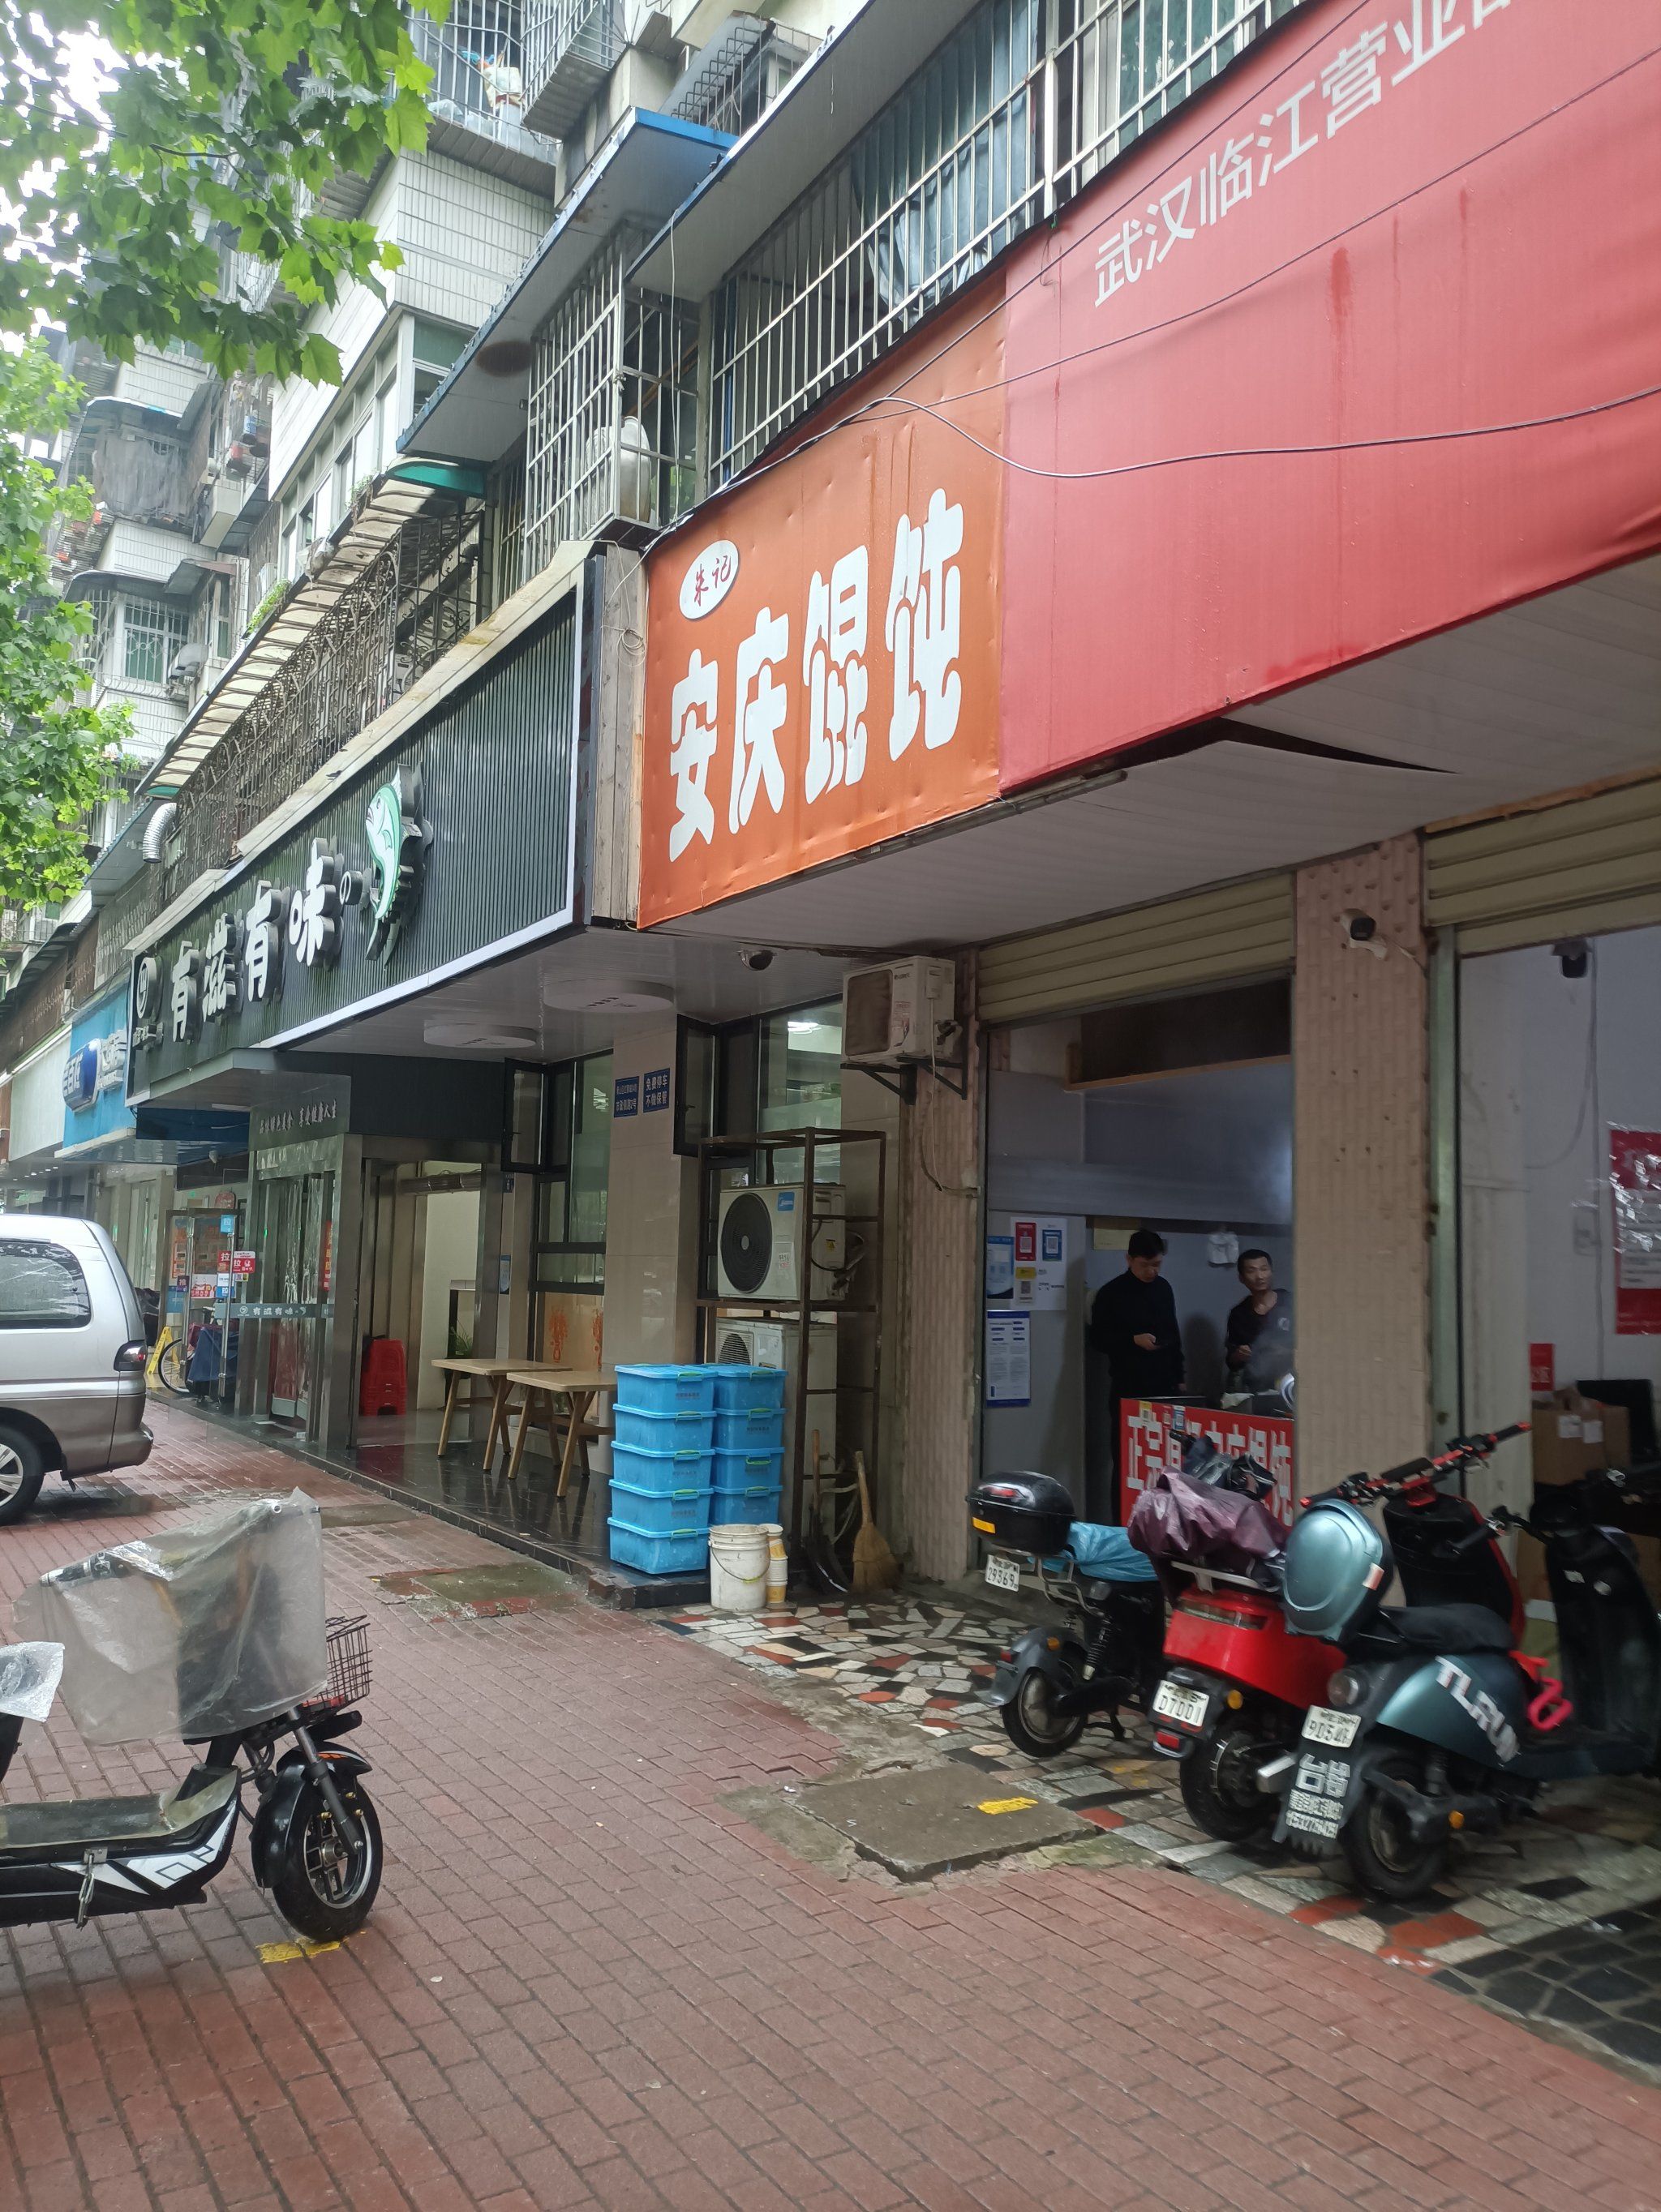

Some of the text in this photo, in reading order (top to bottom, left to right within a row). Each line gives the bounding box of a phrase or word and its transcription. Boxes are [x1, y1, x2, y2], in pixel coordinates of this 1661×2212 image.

[1094, 0, 1512, 309] 武汉临江营业
[669, 487, 964, 863] 安庆馄饨
